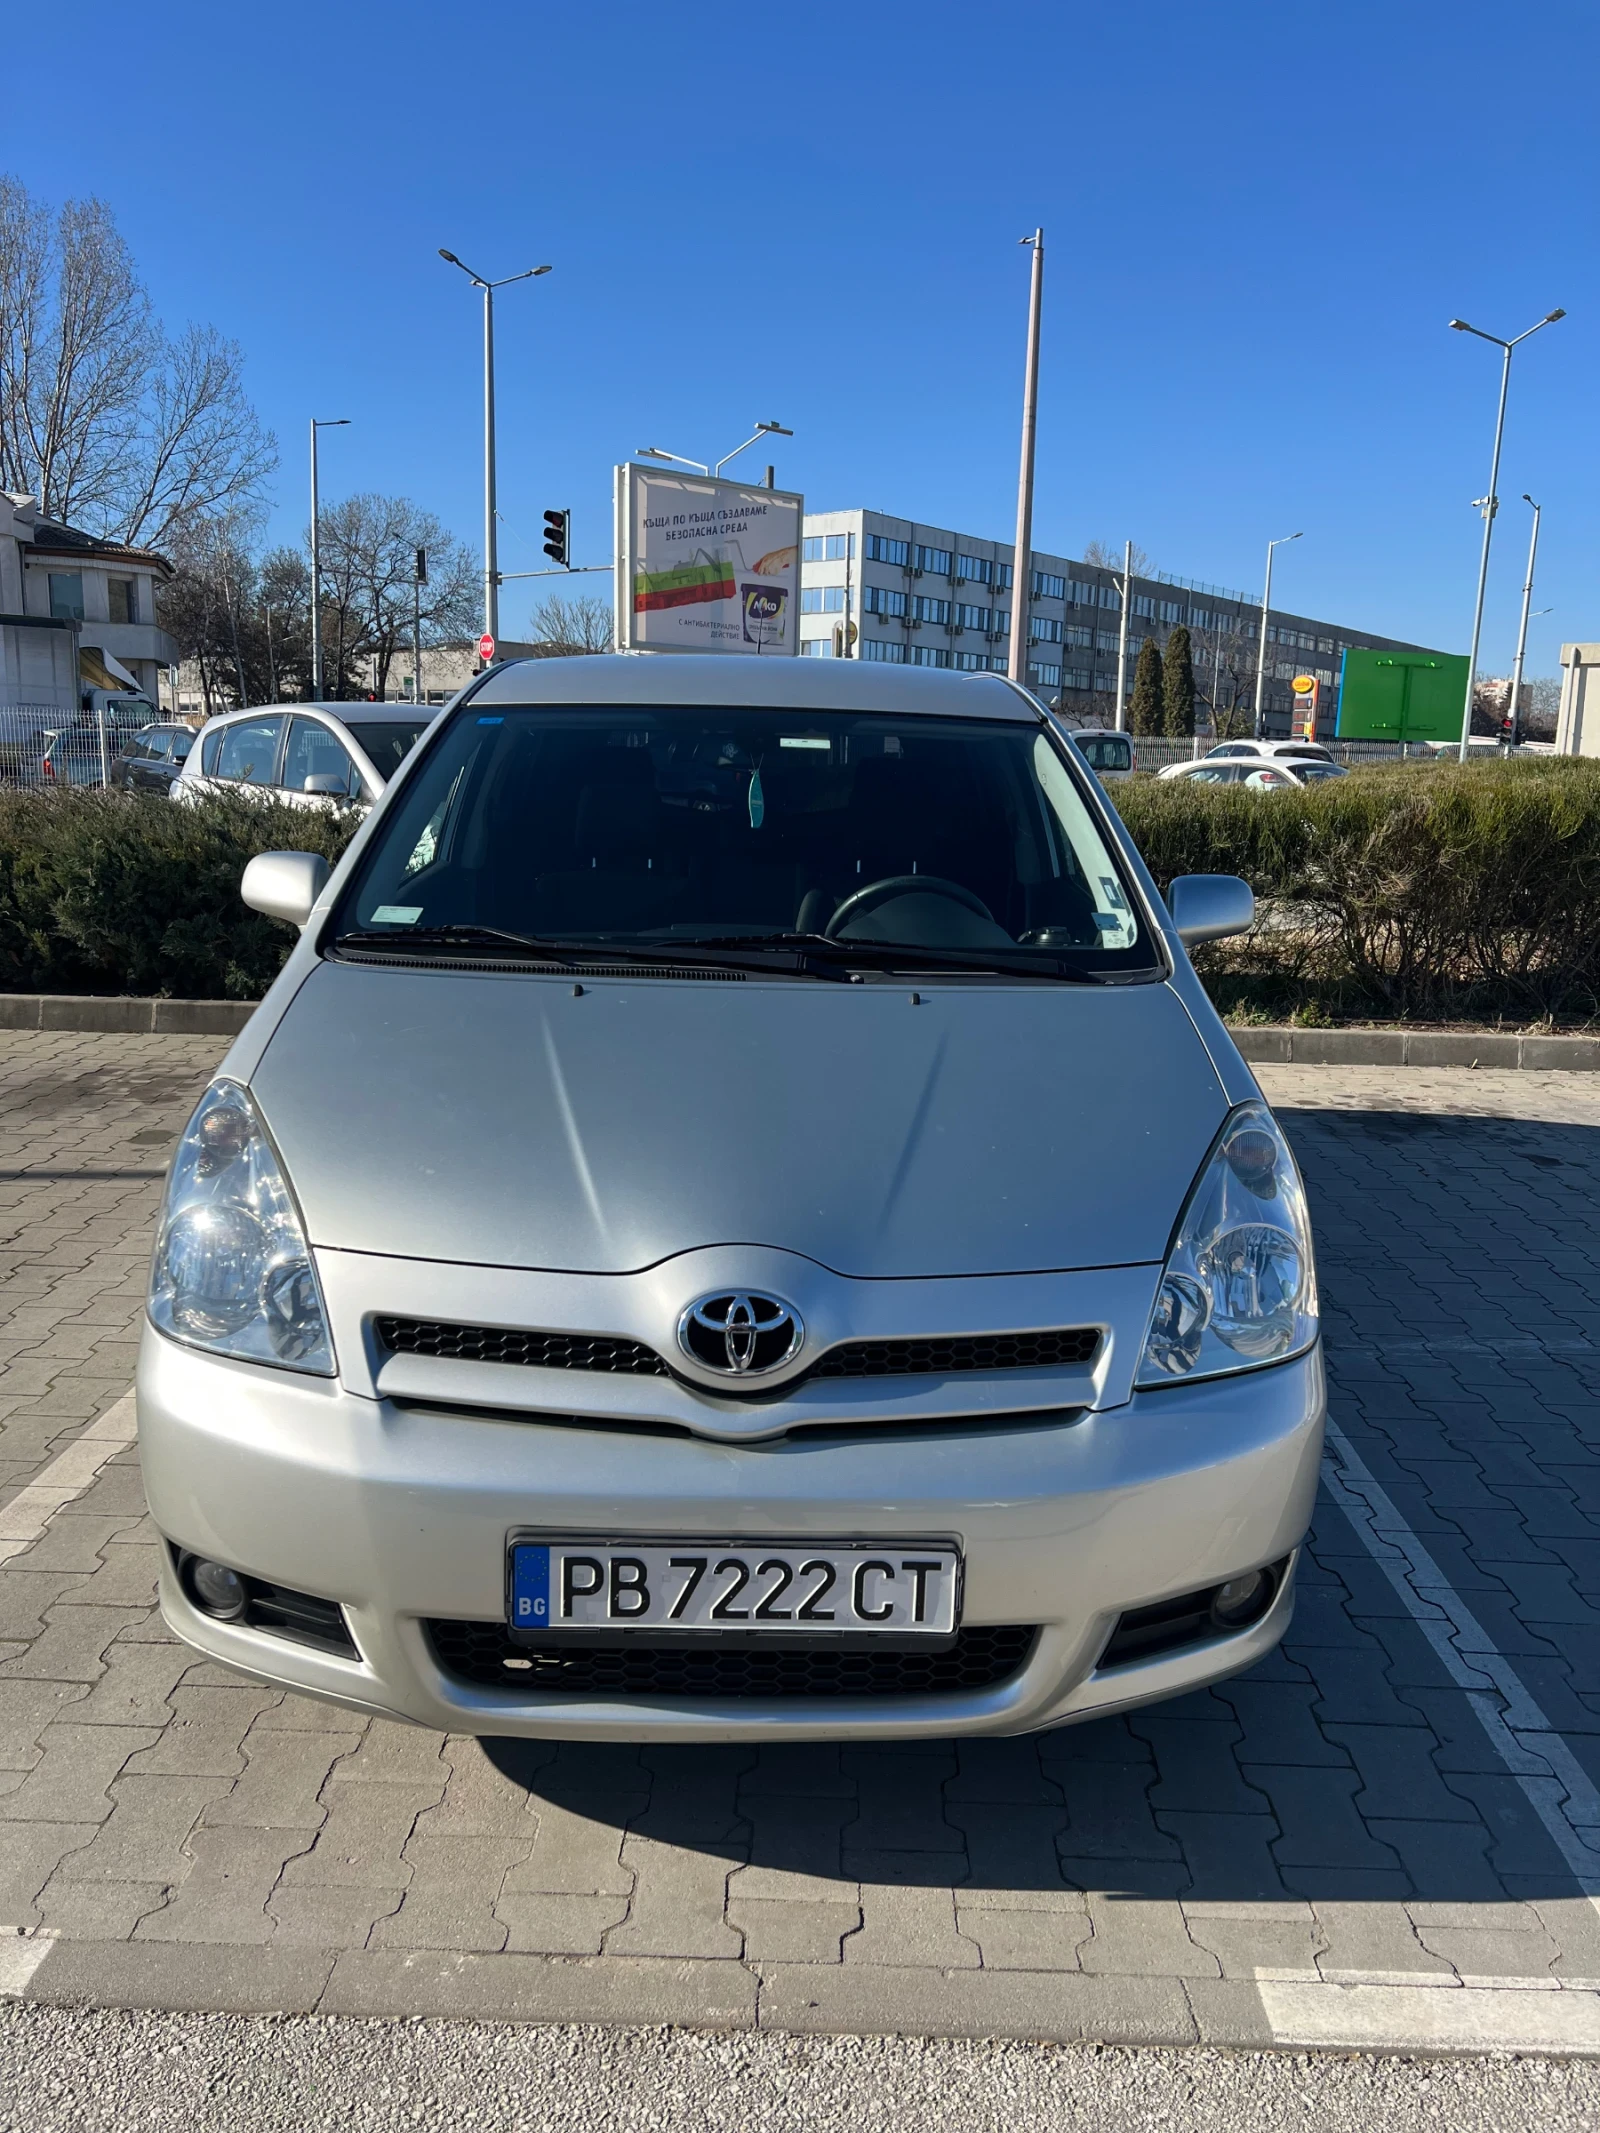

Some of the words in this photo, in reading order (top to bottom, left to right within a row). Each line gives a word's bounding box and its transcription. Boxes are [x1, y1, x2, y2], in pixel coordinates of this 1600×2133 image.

[643, 517, 670, 528] КЪЩА
[673, 515, 686, 525] ПО
[689, 511, 715, 523] КЪЩА
[717, 505, 768, 520] СЪЗДАВАМЕ
[665, 525, 718, 541] БЕЗОПАСНА
[720, 522, 748, 534] СРЕДА
[684, 619, 740, 631] АНТИБАКТЕРИАЛНО
[710, 630, 740, 639] ДЕЙСТВИЕ
[481, 642, 492, 651] STOP
[560, 1556, 651, 1618] PB
[667, 1557, 837, 1621] 7222
[852, 1559, 943, 1622] CT
[518, 1597, 546, 1616] BG
